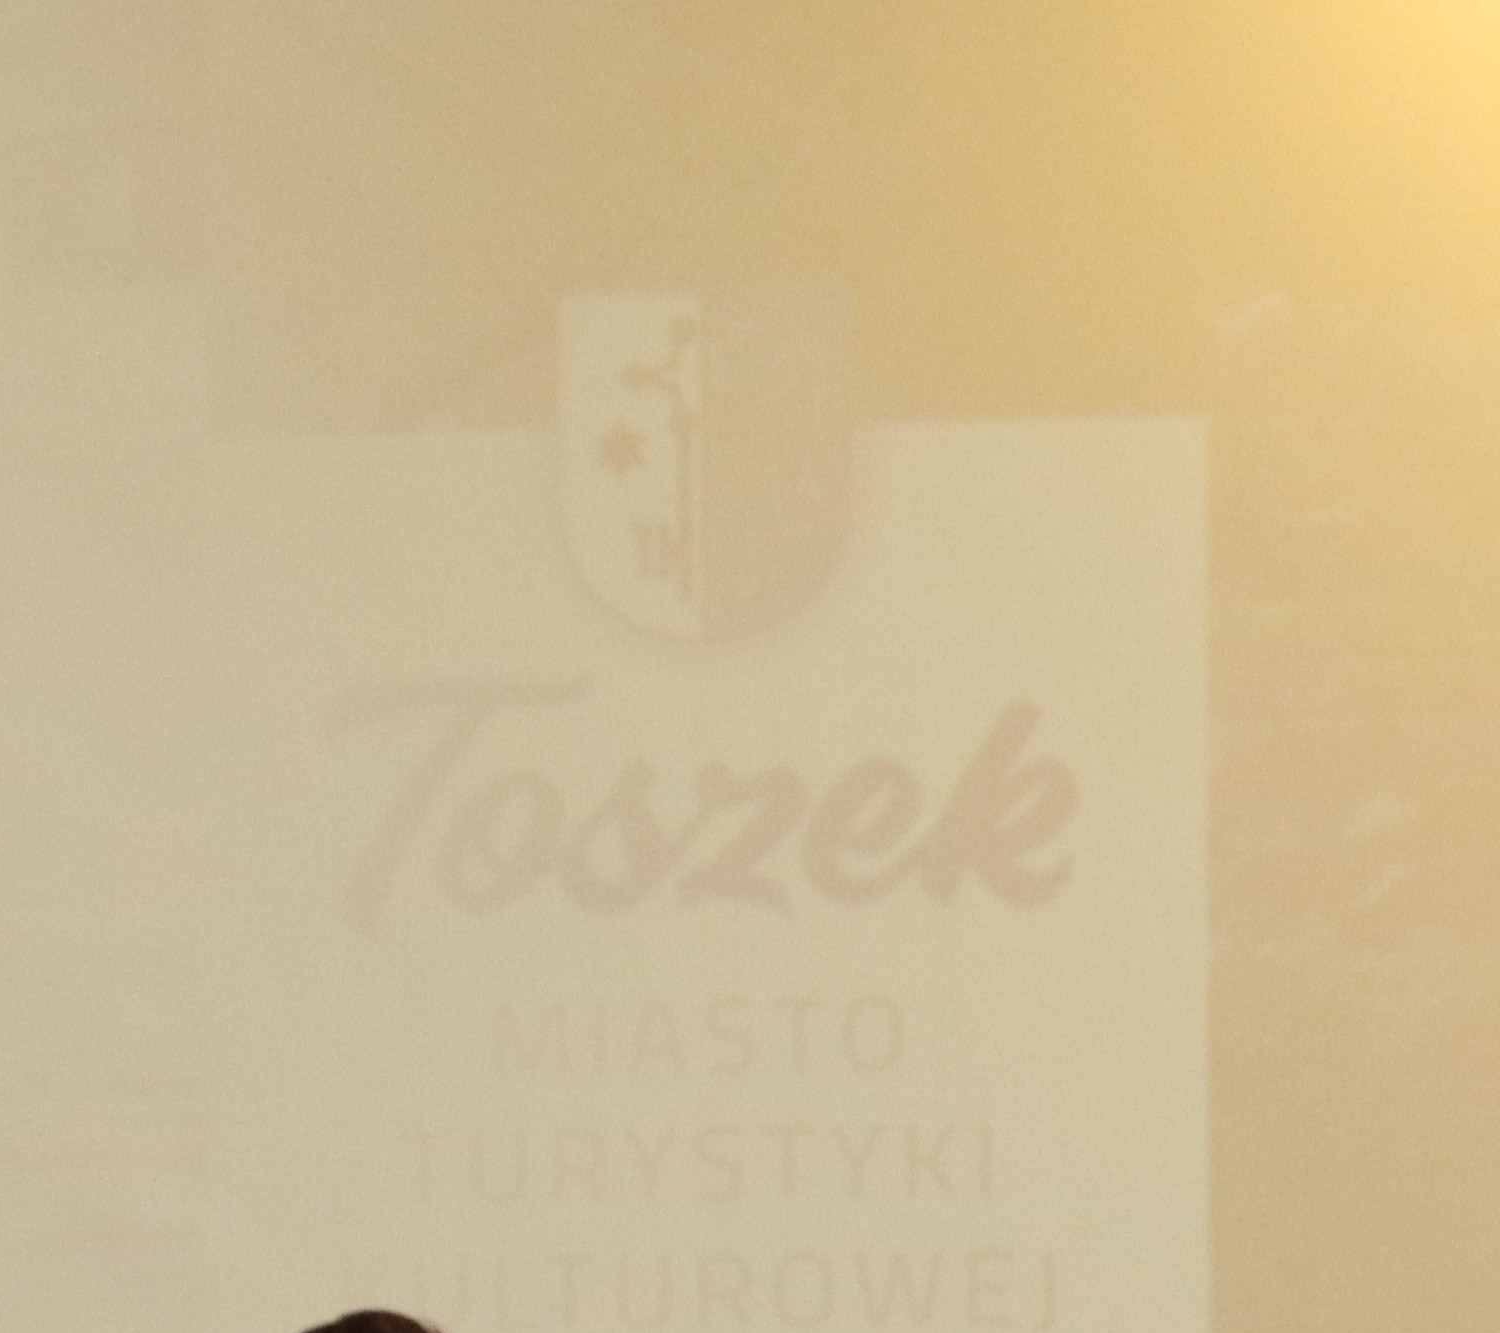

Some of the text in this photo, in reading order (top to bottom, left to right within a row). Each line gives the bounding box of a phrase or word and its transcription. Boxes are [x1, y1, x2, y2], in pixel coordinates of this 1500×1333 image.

[320, 672, 1082, 940] Toszek
[488, 996, 908, 1076] MIASTO
[405, 1123, 998, 1202] TURYSTYKI
